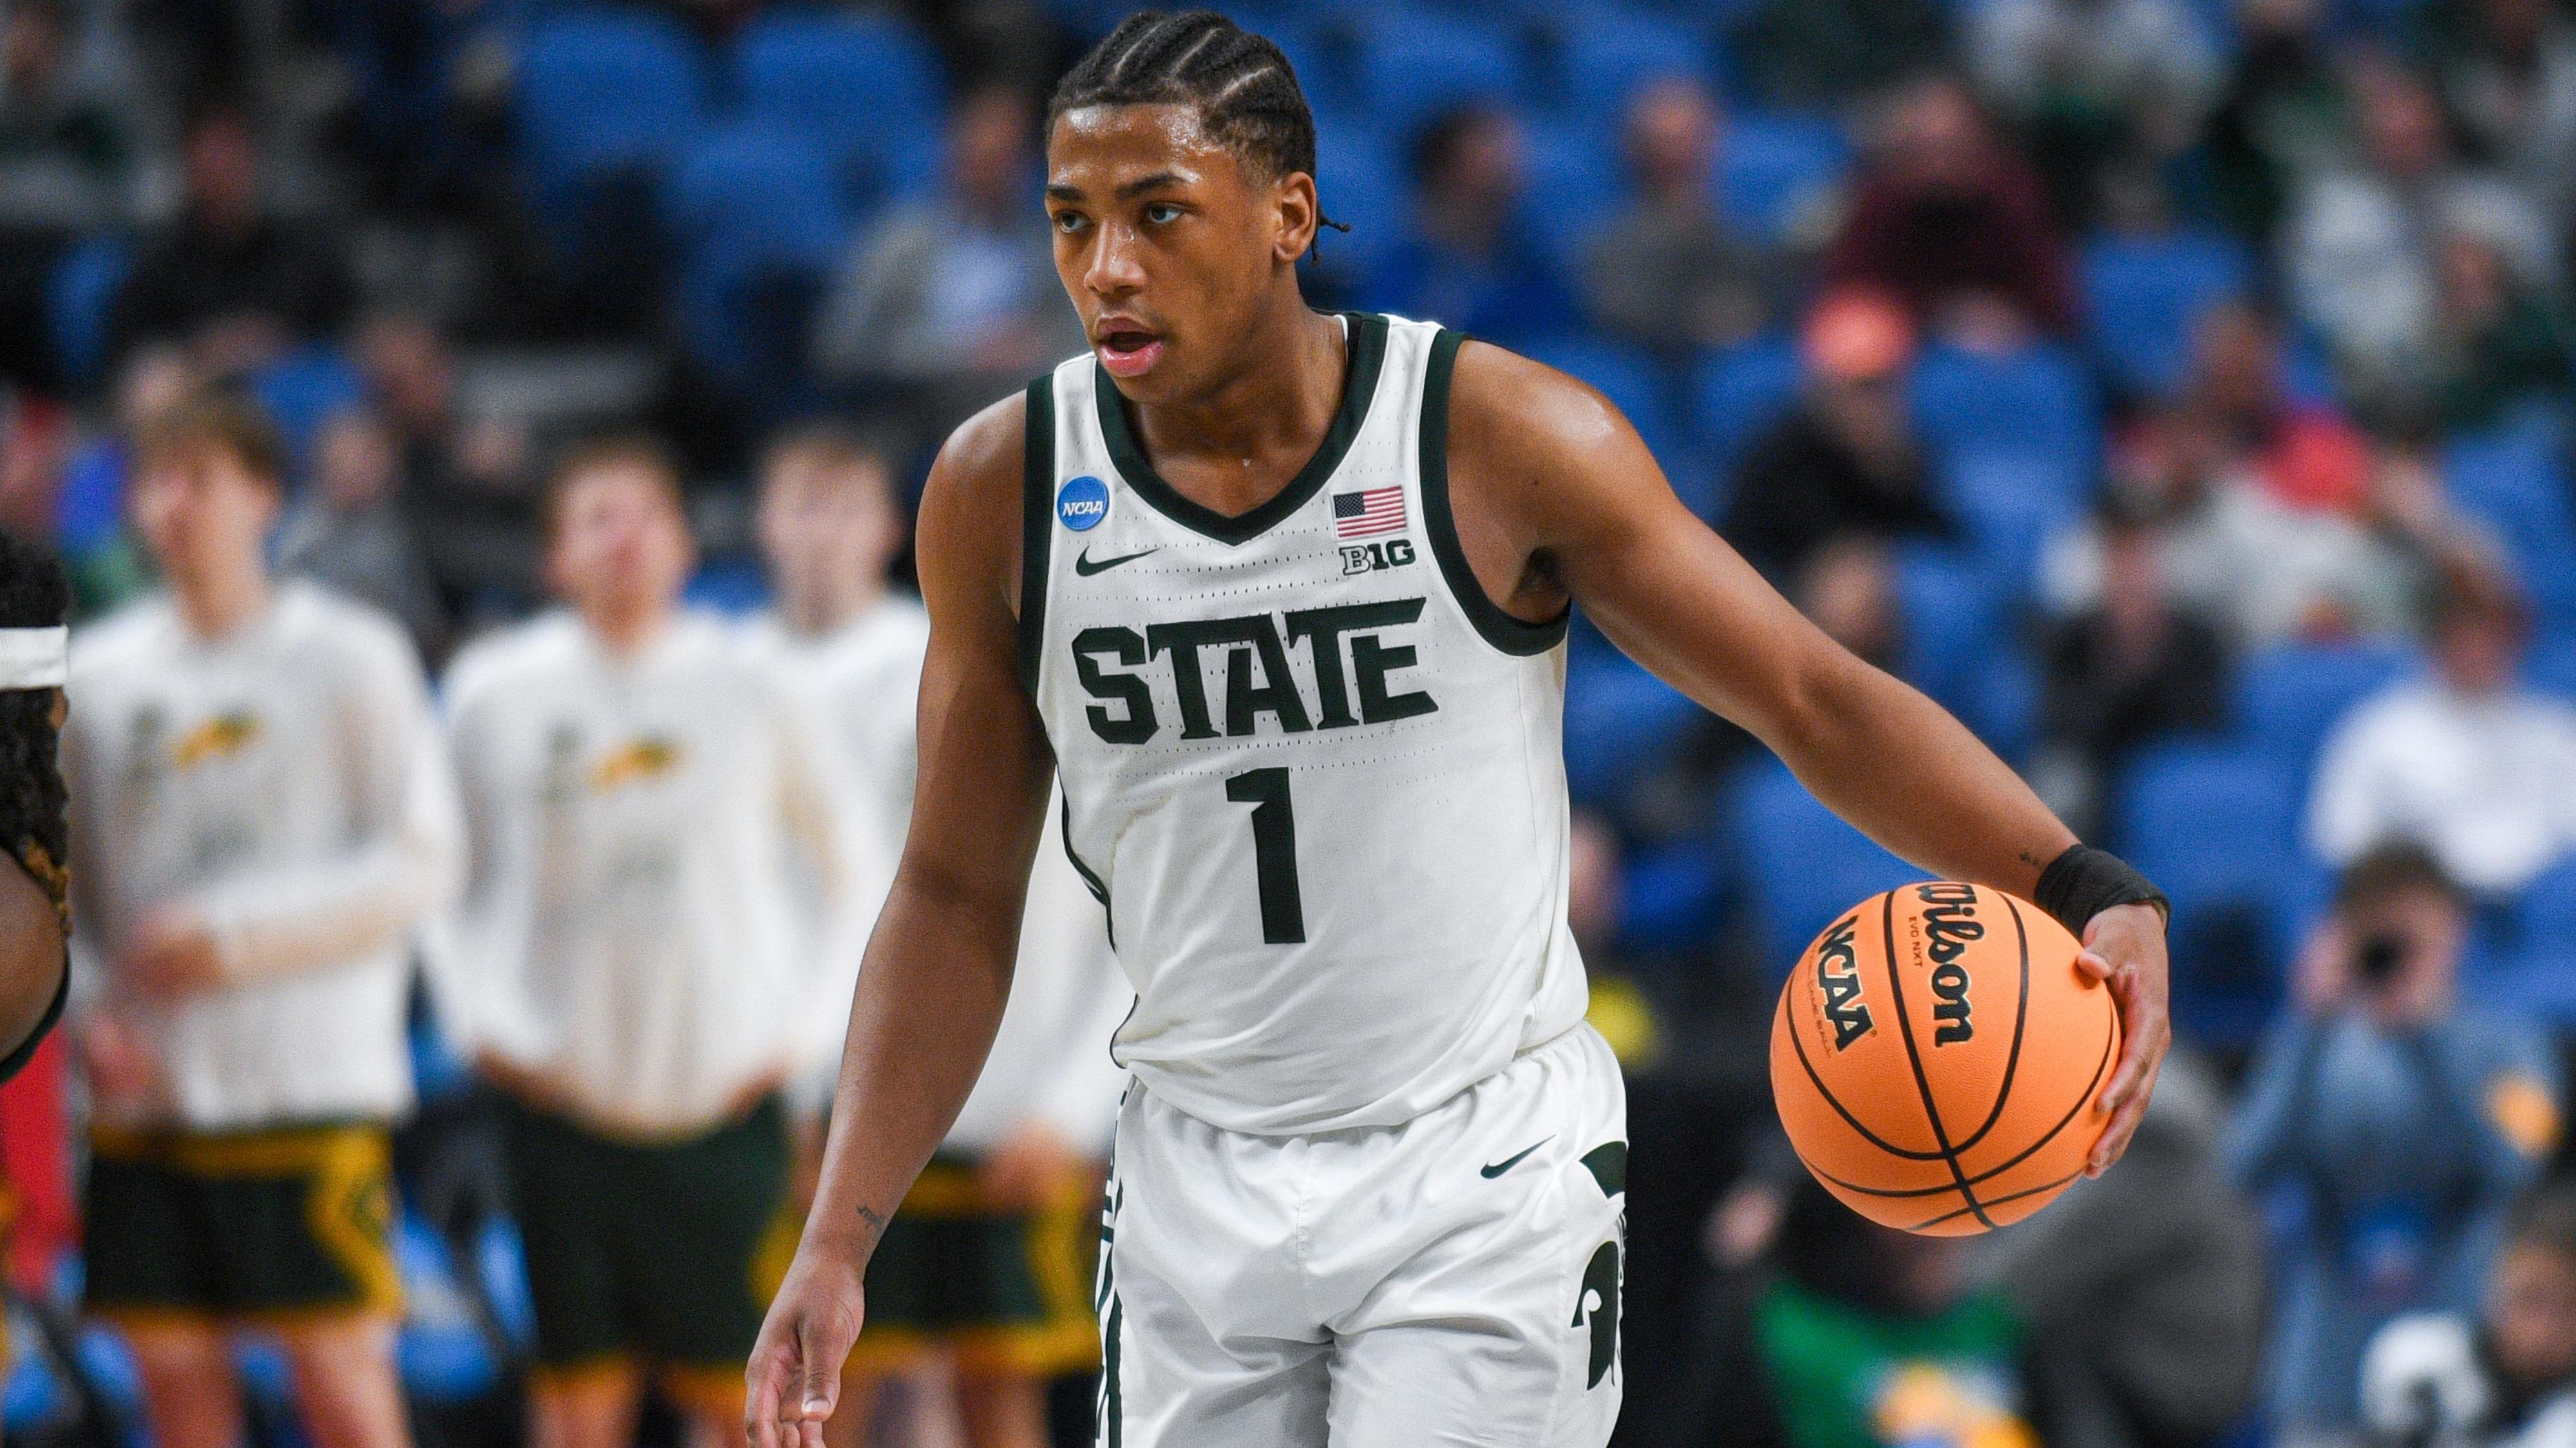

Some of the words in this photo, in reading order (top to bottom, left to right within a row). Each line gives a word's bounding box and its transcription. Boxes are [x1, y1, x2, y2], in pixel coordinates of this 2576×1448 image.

[1062, 500, 1104, 517] NCAA
[1071, 596, 1439, 745] STATE
[1225, 767, 1307, 945] 1
[1817, 914, 1875, 1053] NCAA
[1908, 916, 1920, 938] EVO
[1912, 941, 1923, 967] NXT
[1915, 883, 1985, 1048] Wilson
